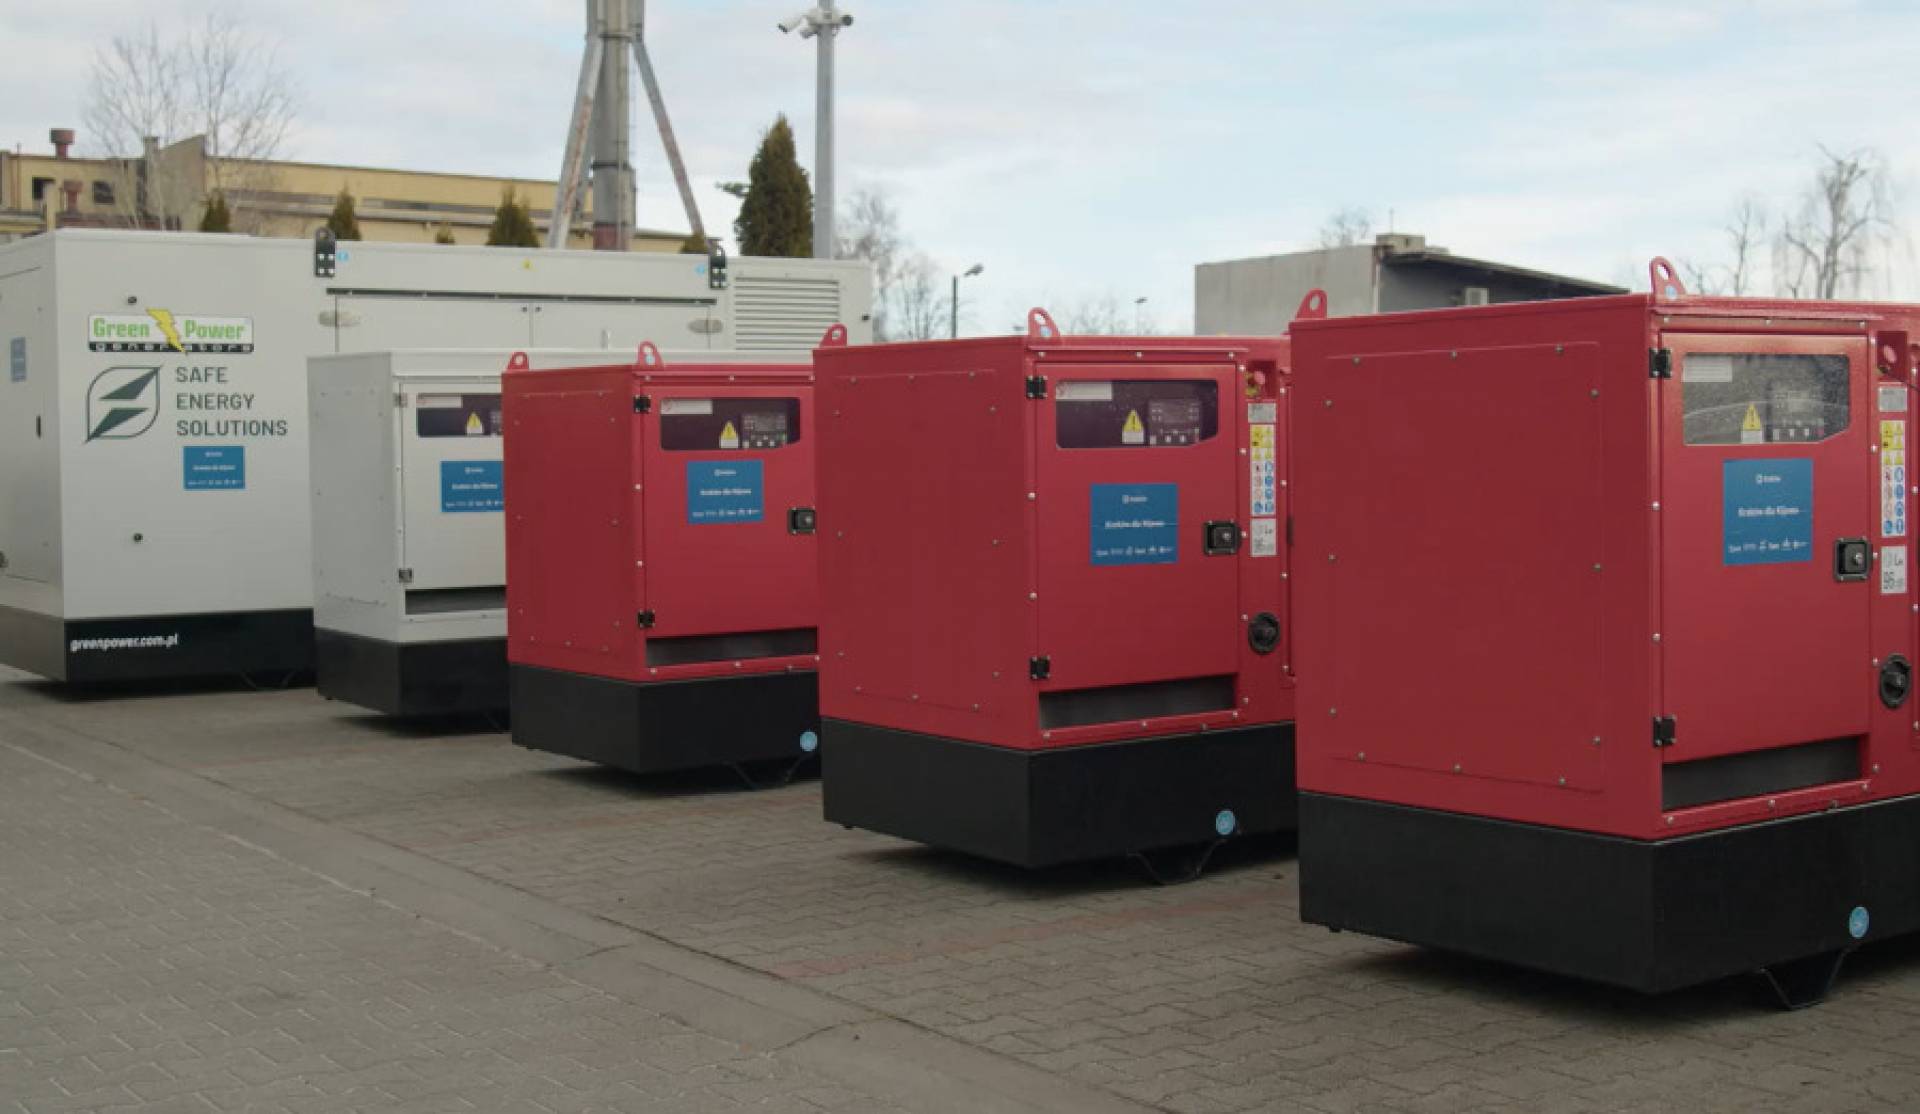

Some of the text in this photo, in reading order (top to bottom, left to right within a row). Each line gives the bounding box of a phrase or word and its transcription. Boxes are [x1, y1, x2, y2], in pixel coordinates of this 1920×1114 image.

[93, 317, 245, 339] Green Power
[175, 366, 228, 383] SAFE
[176, 393, 254, 410] ENERGY
[176, 419, 288, 437] SOLUTIONS
[70, 633, 177, 653] greenpower.com.pl
